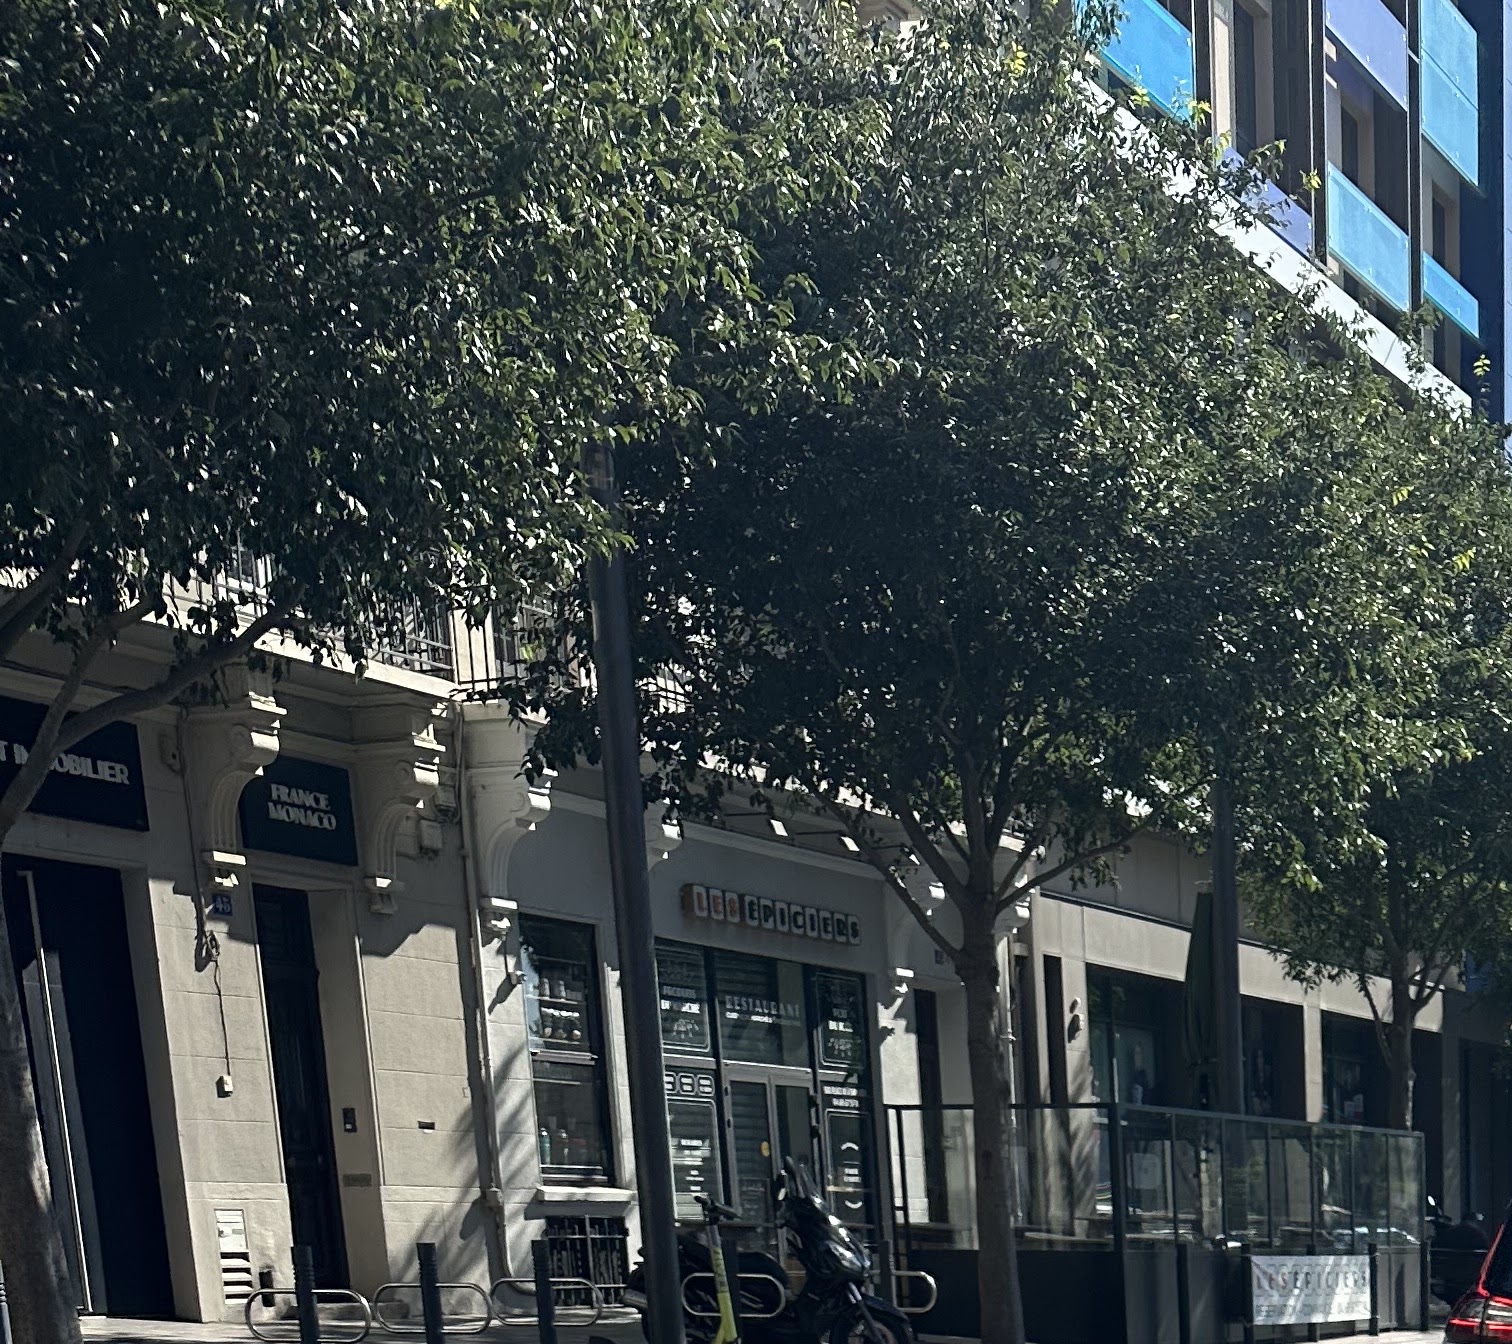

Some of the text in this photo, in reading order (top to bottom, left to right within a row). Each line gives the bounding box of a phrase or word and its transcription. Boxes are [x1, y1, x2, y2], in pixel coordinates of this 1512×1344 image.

[13, 743, 130, 785] IOBILIER
[271, 784, 331, 811] FRANCE
[267, 802, 337, 830] MONACO
